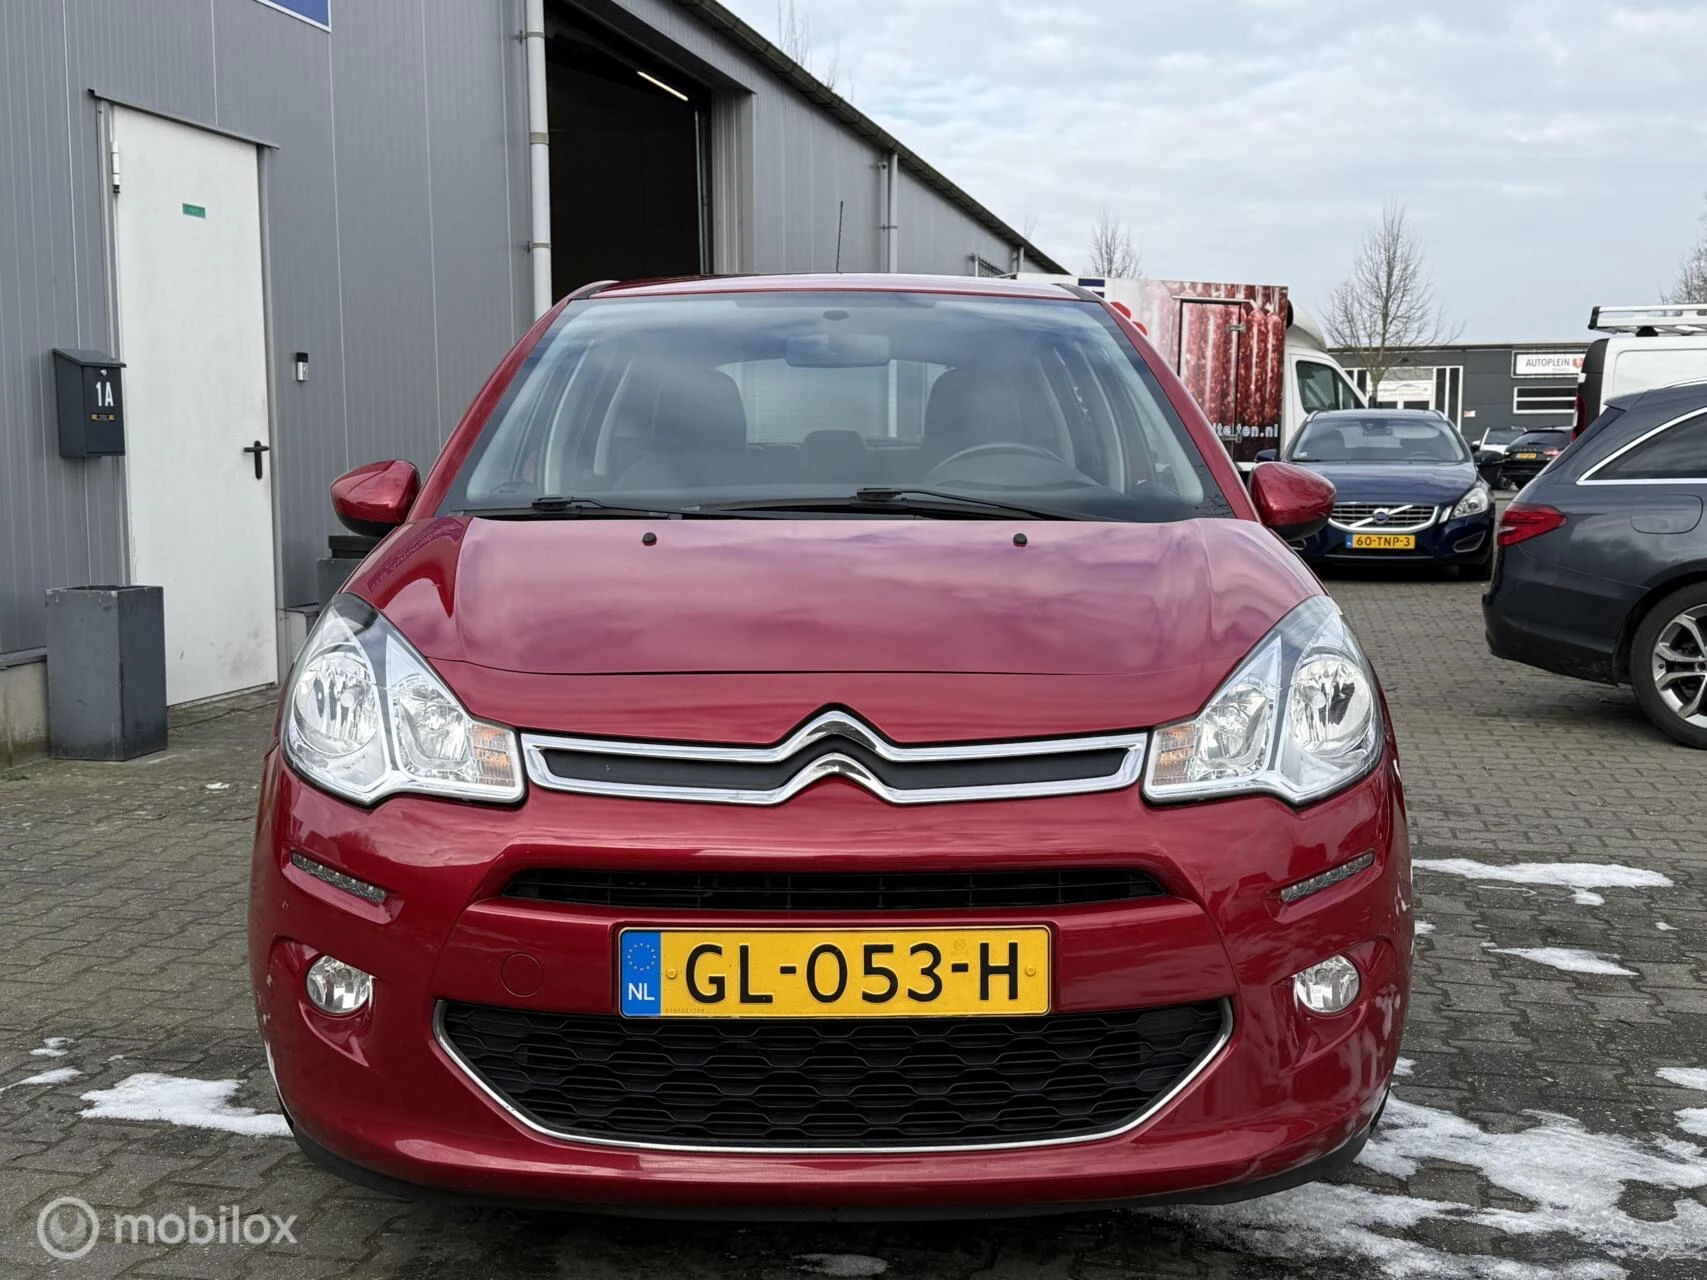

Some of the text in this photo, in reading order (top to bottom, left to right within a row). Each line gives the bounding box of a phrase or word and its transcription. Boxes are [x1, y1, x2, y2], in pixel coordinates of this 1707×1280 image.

[1525, 358, 1570, 367] AUTOPLEIN
[95, 381, 114, 407] 1A
[1356, 536, 1411, 547] 60-TNP-3
[685, 941, 1019, 1004] GL-053-H
[628, 982, 655, 1001] NL
